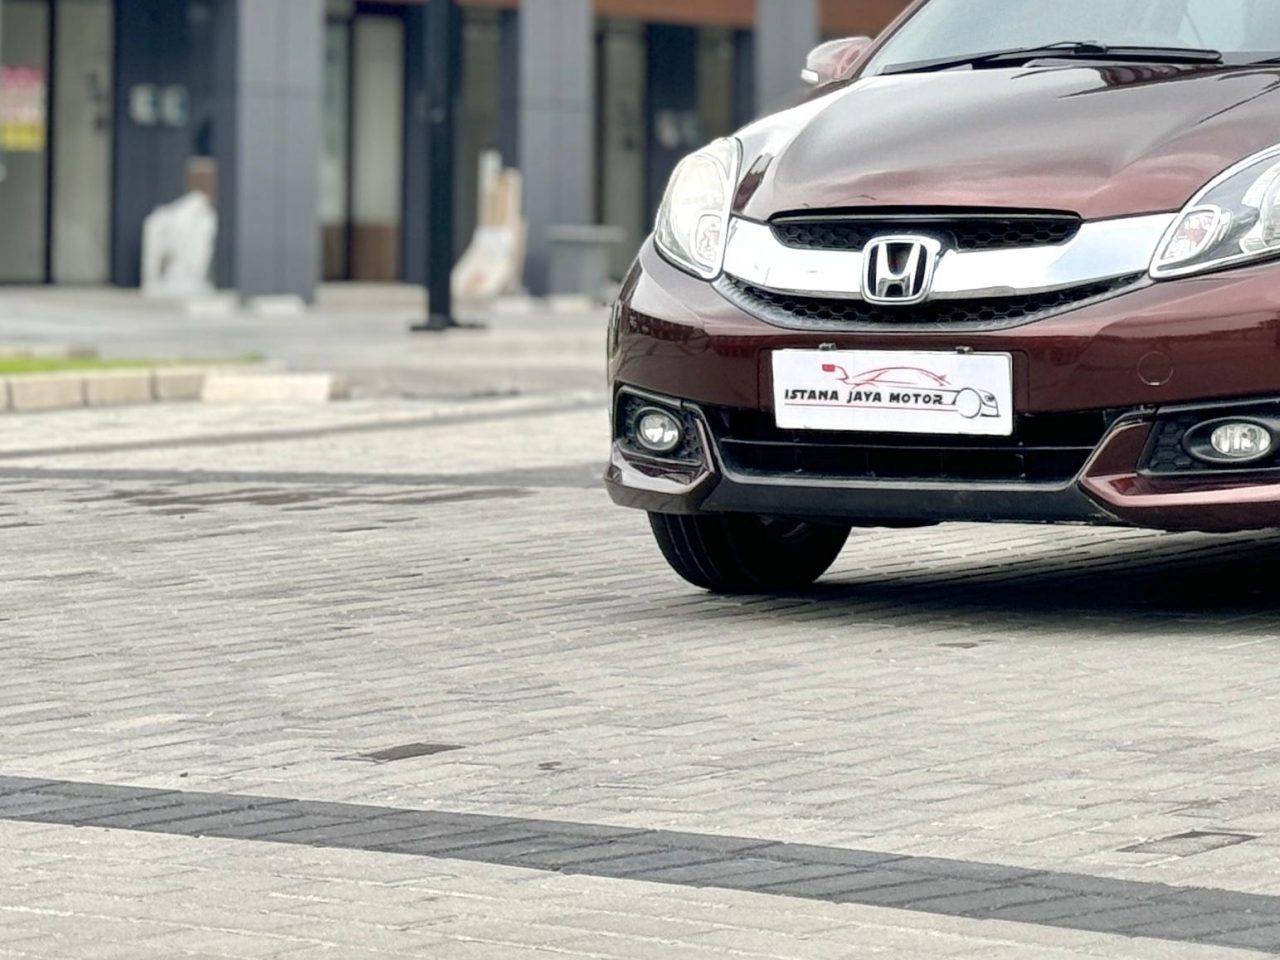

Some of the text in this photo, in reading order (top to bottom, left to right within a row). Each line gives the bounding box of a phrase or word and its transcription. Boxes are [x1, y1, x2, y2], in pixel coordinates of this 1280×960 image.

[784, 388, 944, 405] ISTANA JAYA MOTOR
